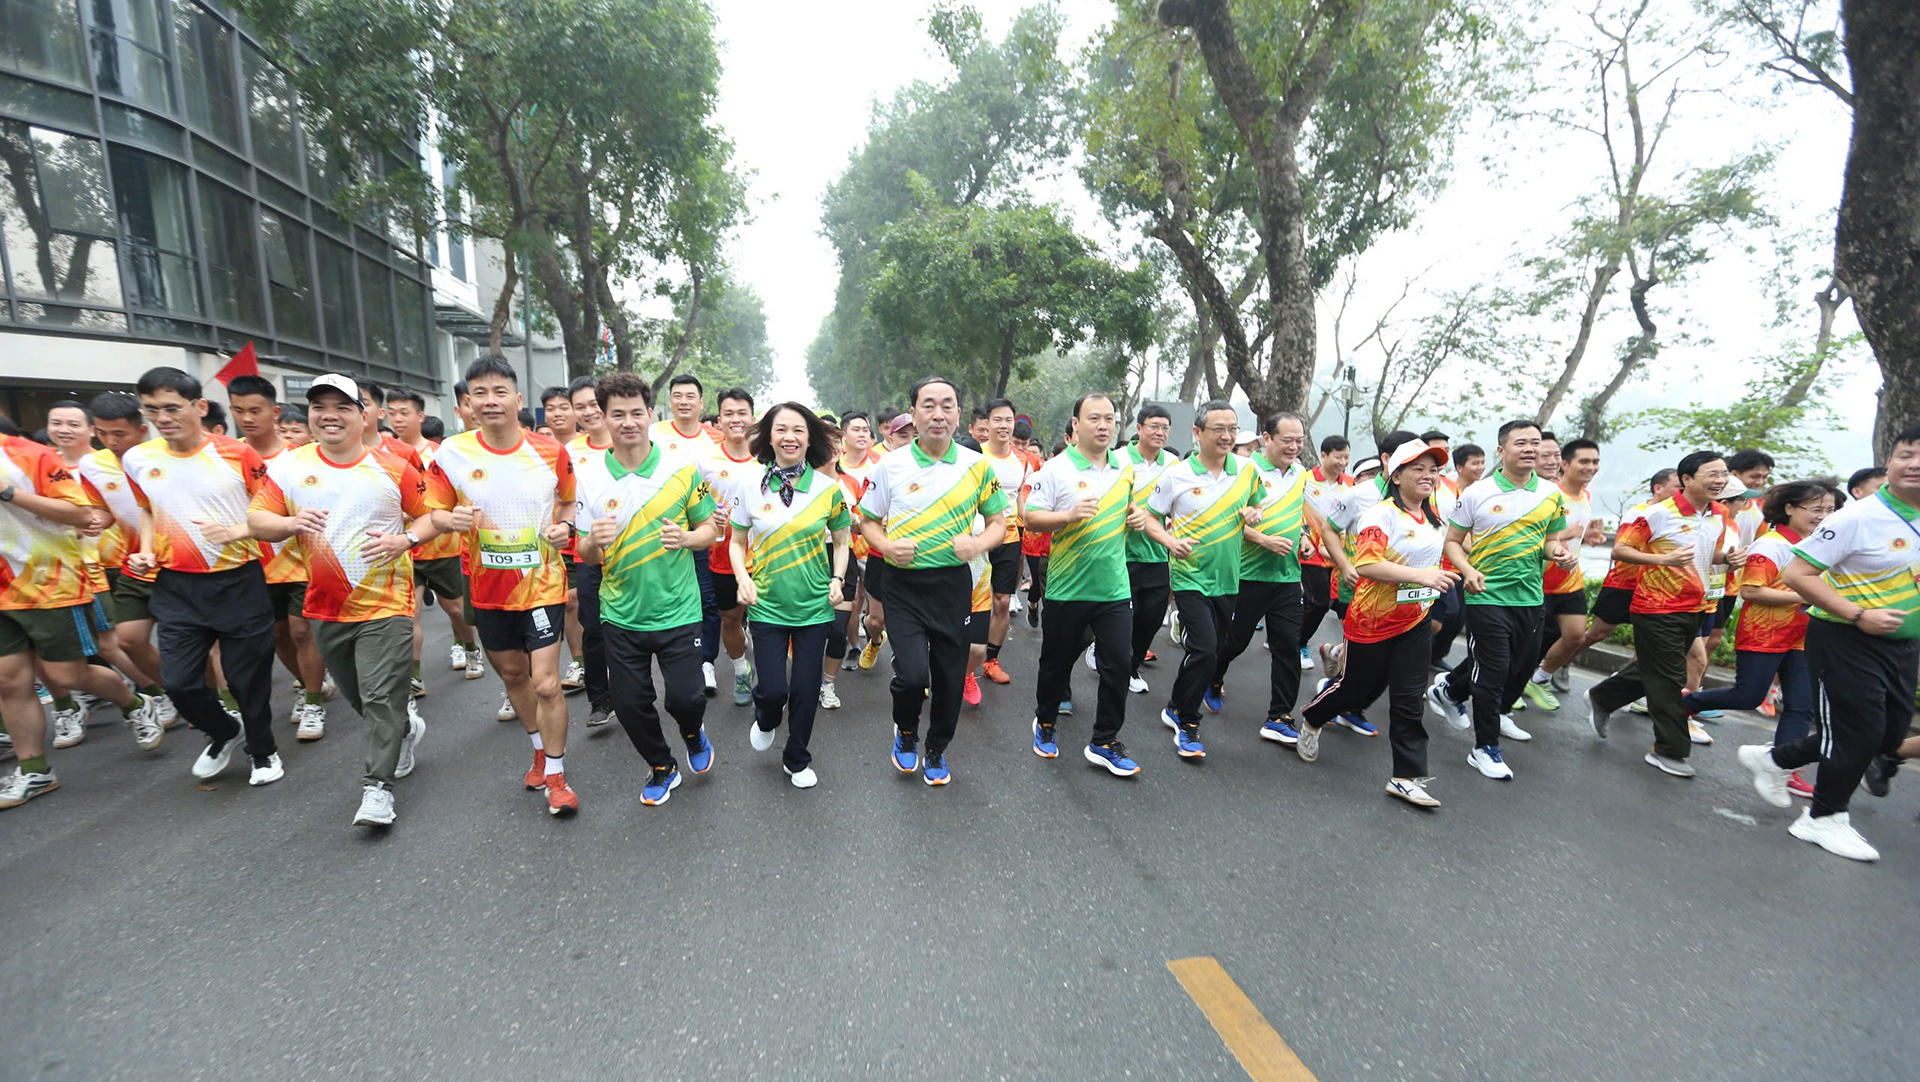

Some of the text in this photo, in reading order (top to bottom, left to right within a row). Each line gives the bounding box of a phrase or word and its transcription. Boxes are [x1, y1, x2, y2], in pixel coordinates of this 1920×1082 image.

[488, 554, 513, 565] T09
[523, 554, 532, 563] 3
[1427, 588, 1433, 596] 3
